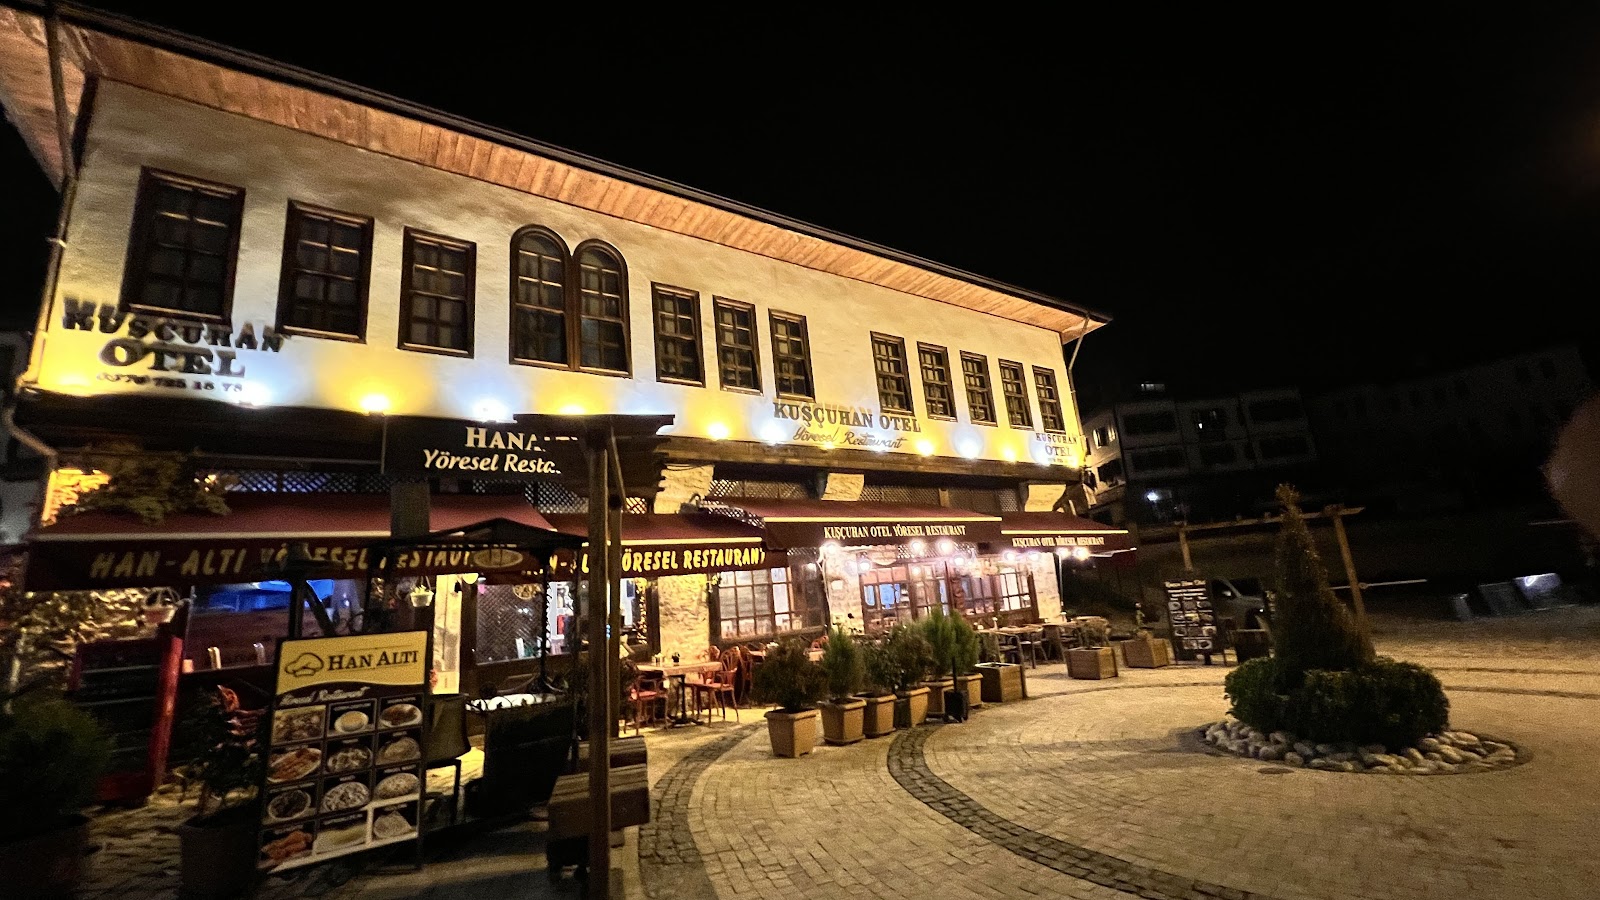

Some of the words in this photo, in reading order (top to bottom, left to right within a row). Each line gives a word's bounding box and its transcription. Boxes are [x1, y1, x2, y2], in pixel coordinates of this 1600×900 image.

[99, 338, 245, 378] OTEL
[773, 402, 873, 428] KUŞÇUHAN
[879, 415, 921, 433] OTEL
[465, 426, 578, 452] HANA
[840, 431, 907, 449] Restaurant
[424, 449, 498, 472] Yöresel
[504, 453, 562, 474] Resta
[824, 526, 869, 540] KUŞÇUHAN
[870, 525, 892, 538] OTEL
[893, 524, 925, 537] YÖRESEL
[925, 525, 966, 536] RESTAURANT
[90, 551, 160, 578] HAN
[181, 549, 247, 575] ALTI
[621, 548, 679, 573] ÖRESEL
[328, 654, 373, 671] HAN
[376, 651, 419, 667] ALTI
